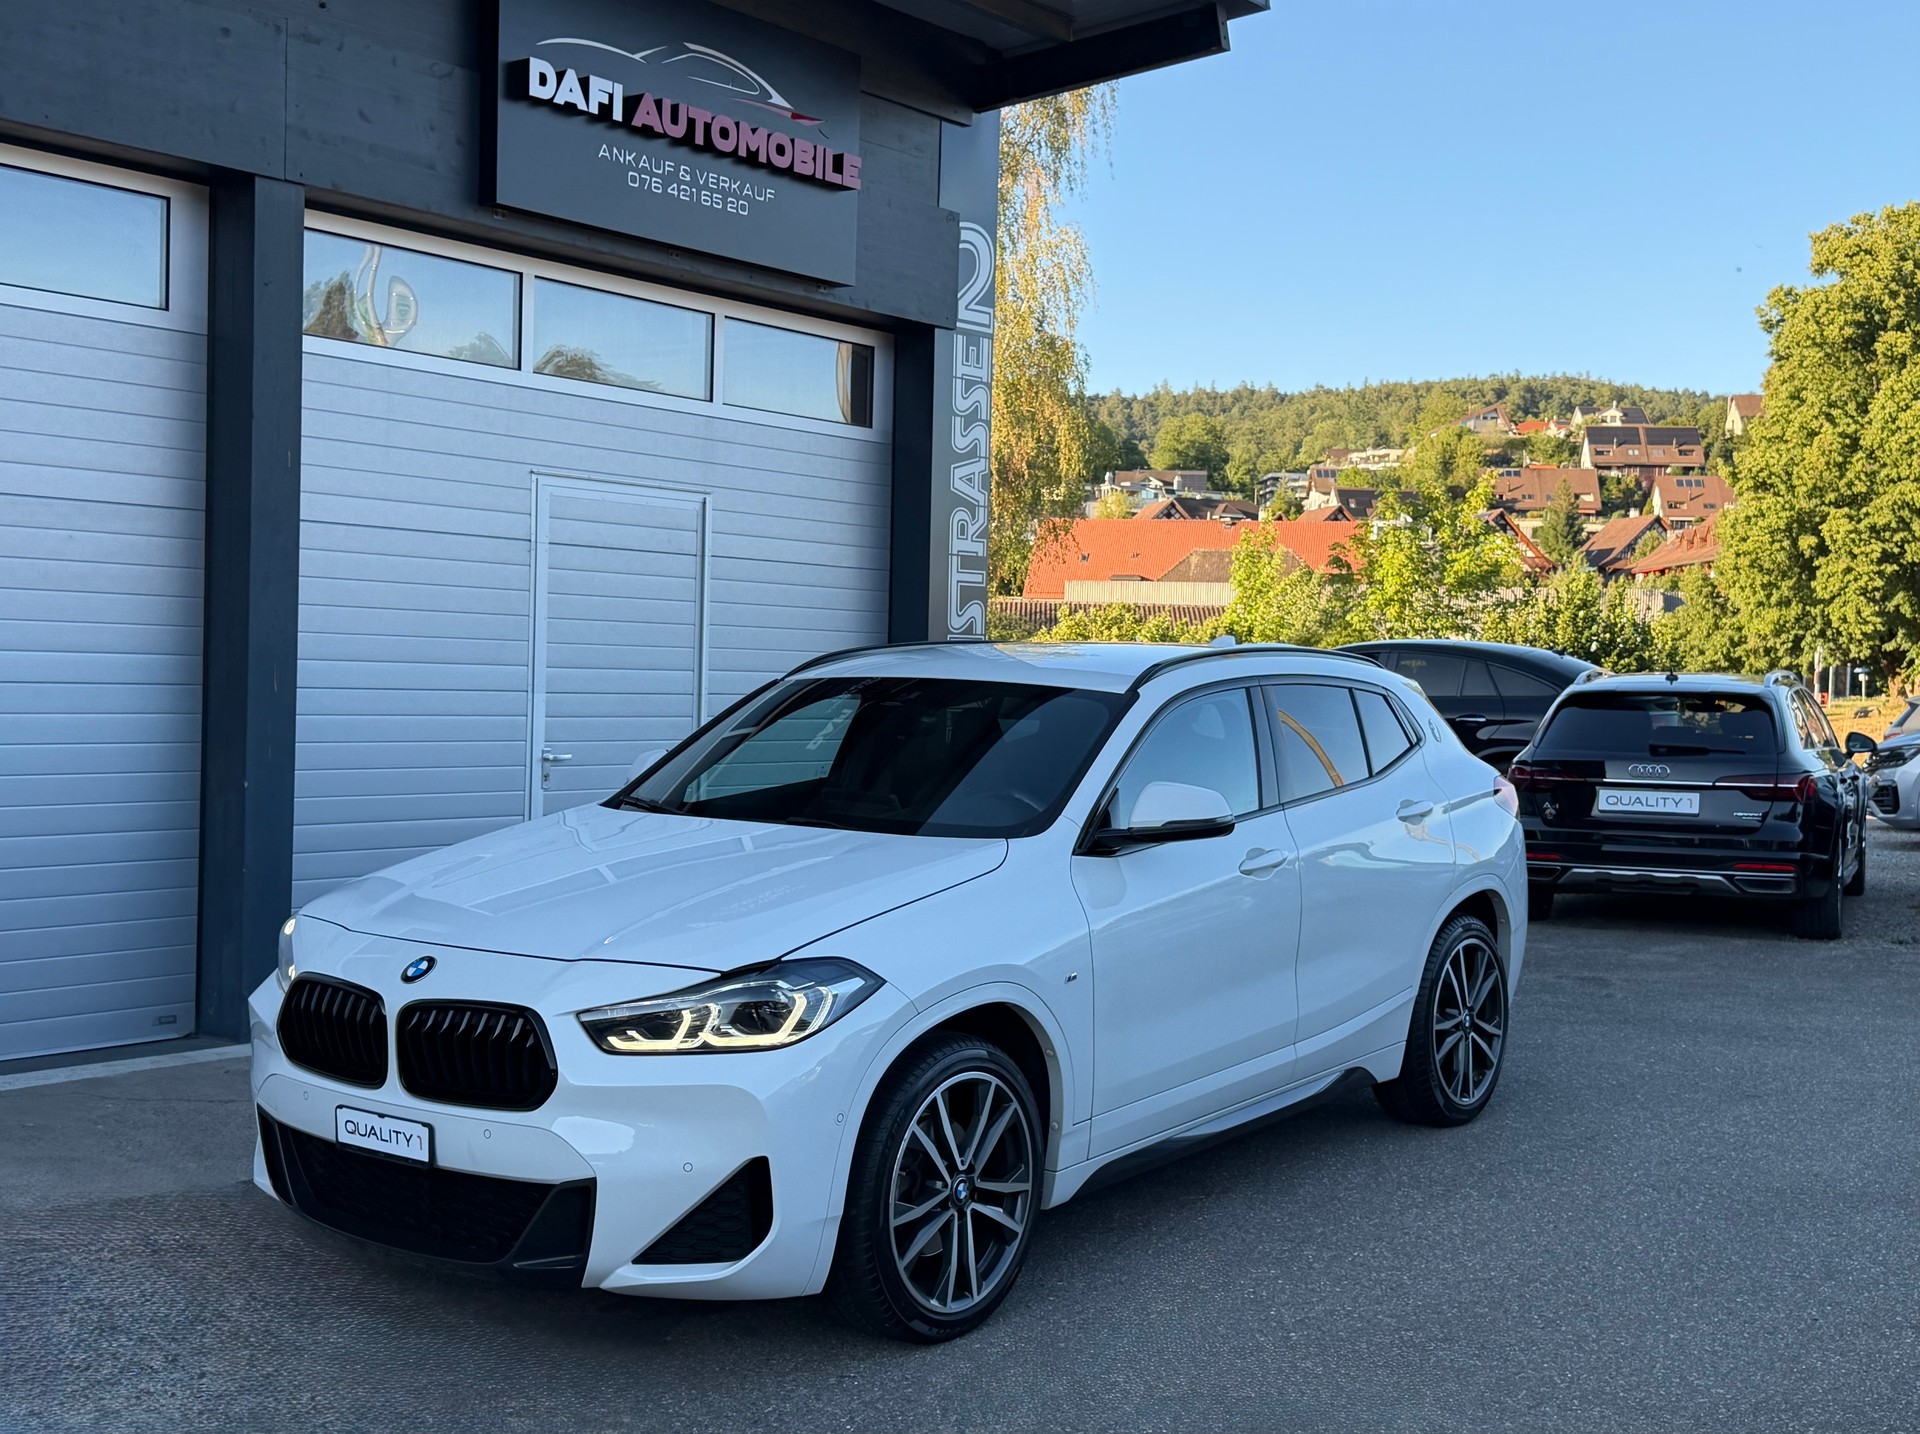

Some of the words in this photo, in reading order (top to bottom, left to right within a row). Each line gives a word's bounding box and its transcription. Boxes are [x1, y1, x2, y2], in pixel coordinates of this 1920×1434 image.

[529, 56, 623, 122] DAFI
[631, 92, 862, 190] AUTOMOBILE
[598, 144, 675, 176] ANKAUF
[679, 165, 691, 181] &
[696, 169, 776, 202] VERKAUF
[628, 171, 663, 193] 076
[667, 183, 697, 202] 421
[701, 190, 723, 209] 65
[727, 198, 749, 215] 20
[947, 333, 993, 641] STRASSE
[1605, 795, 1683, 808] QUALITY
[1686, 798, 1693, 809] 1
[344, 1119, 413, 1148] QUALITY
[417, 1135, 423, 1151] 1
